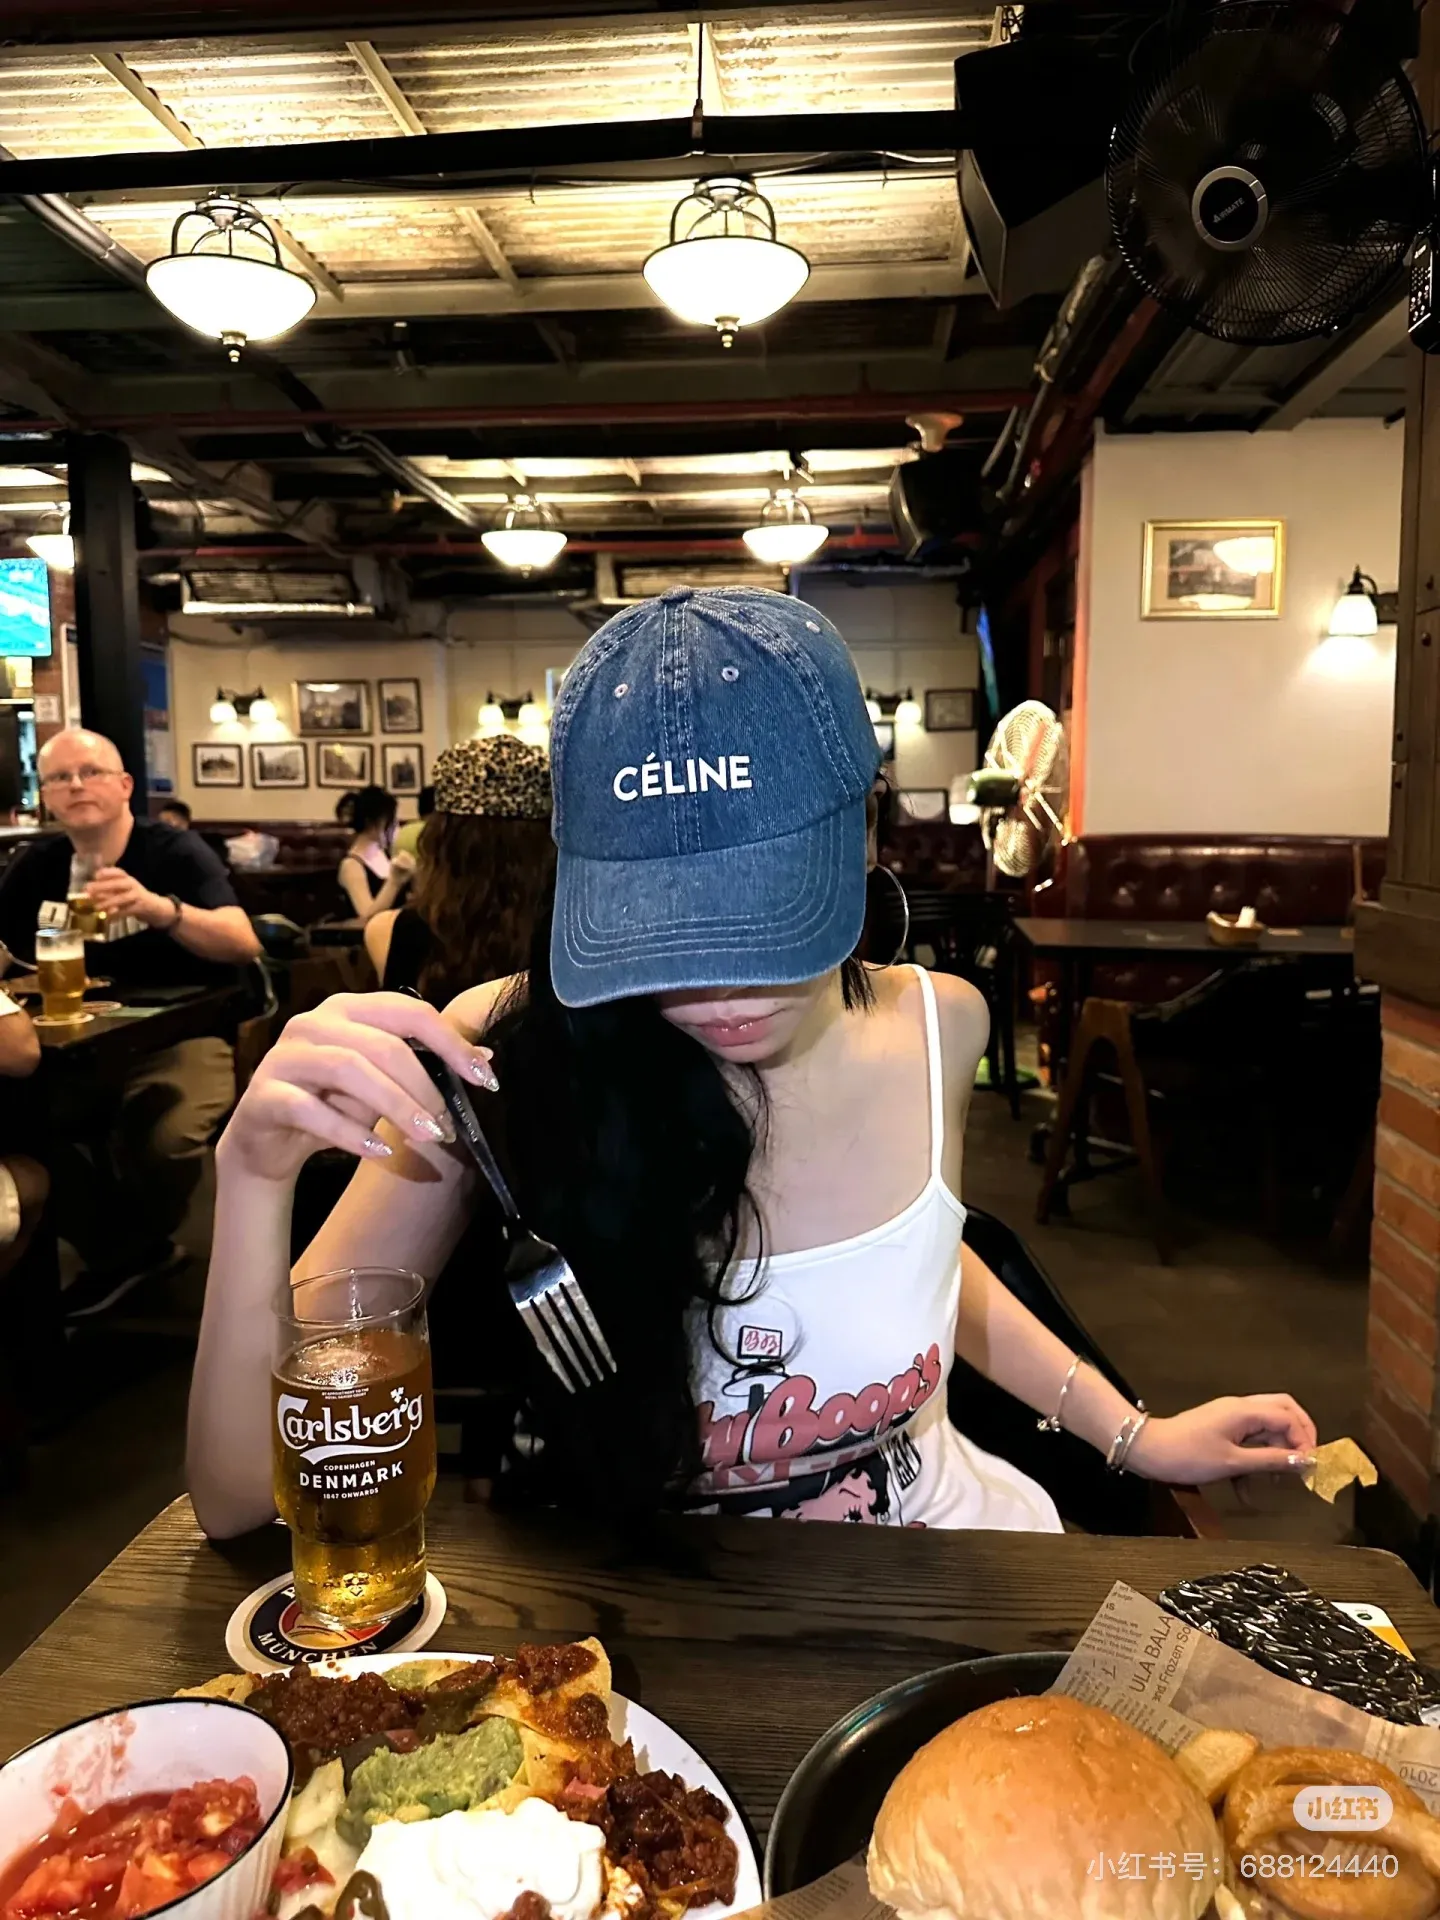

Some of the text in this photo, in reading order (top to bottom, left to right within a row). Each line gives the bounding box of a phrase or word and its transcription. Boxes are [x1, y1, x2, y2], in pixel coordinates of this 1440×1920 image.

[612, 752, 753, 801] CÉLINE
[277, 1391, 423, 1451] Carlsberg
[299, 1461, 404, 1489] DENMARK
[323, 1460, 376, 1471] COPENHAGEN
[341, 1487, 379, 1499] ONWARDS
[1159, 1644, 1185, 1685] Frozen
